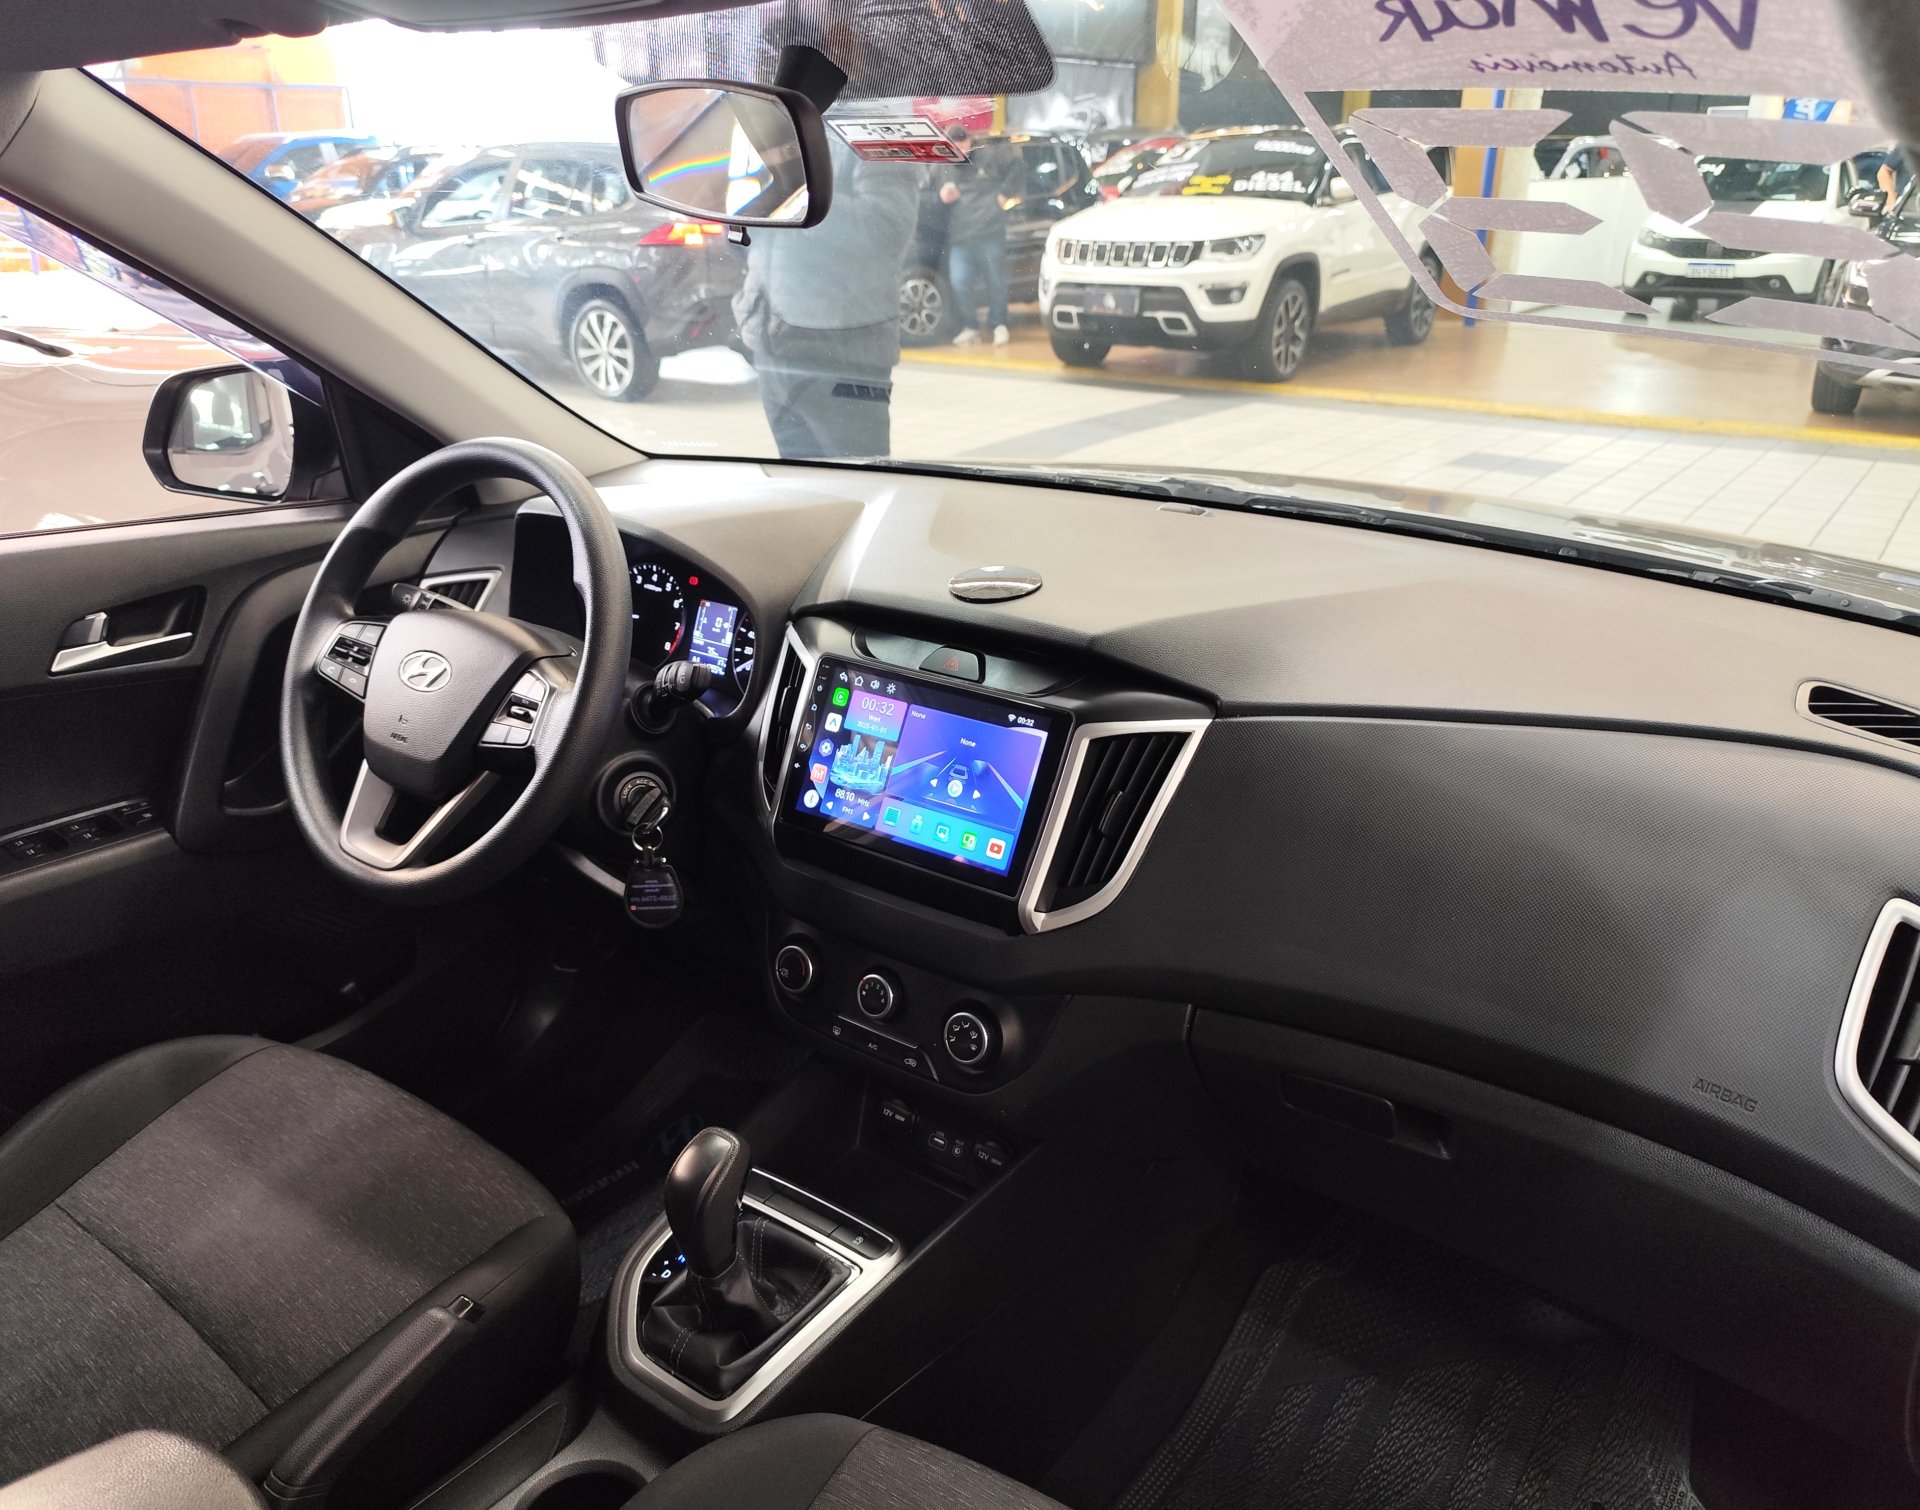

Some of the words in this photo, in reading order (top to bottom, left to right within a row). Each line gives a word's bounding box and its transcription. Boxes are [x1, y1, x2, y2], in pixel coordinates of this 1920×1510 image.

[1233, 179, 1307, 193] DIESEL
[651, 573, 658, 582] 4
[666, 582, 672, 591] 5
[673, 600, 679, 608] 6
[665, 642, 671, 650] 8
[861, 697, 895, 716] 00:32
[911, 710, 927, 720] None
[857, 720, 888, 734] 2025-01-01
[1017, 716, 1035, 727] 00:32
[960, 737, 977, 748] None
[622, 784, 633, 799] LOCK
[834, 788, 856, 802] 88.10
[857, 797, 870, 807] MHz
[841, 806, 854, 815] FM1
[867, 1042, 879, 1051] A/C
[1692, 1078, 1758, 1113] AIRBAG
[883, 1107, 894, 1118] 12V
[978, 1150, 989, 1160] 12V
